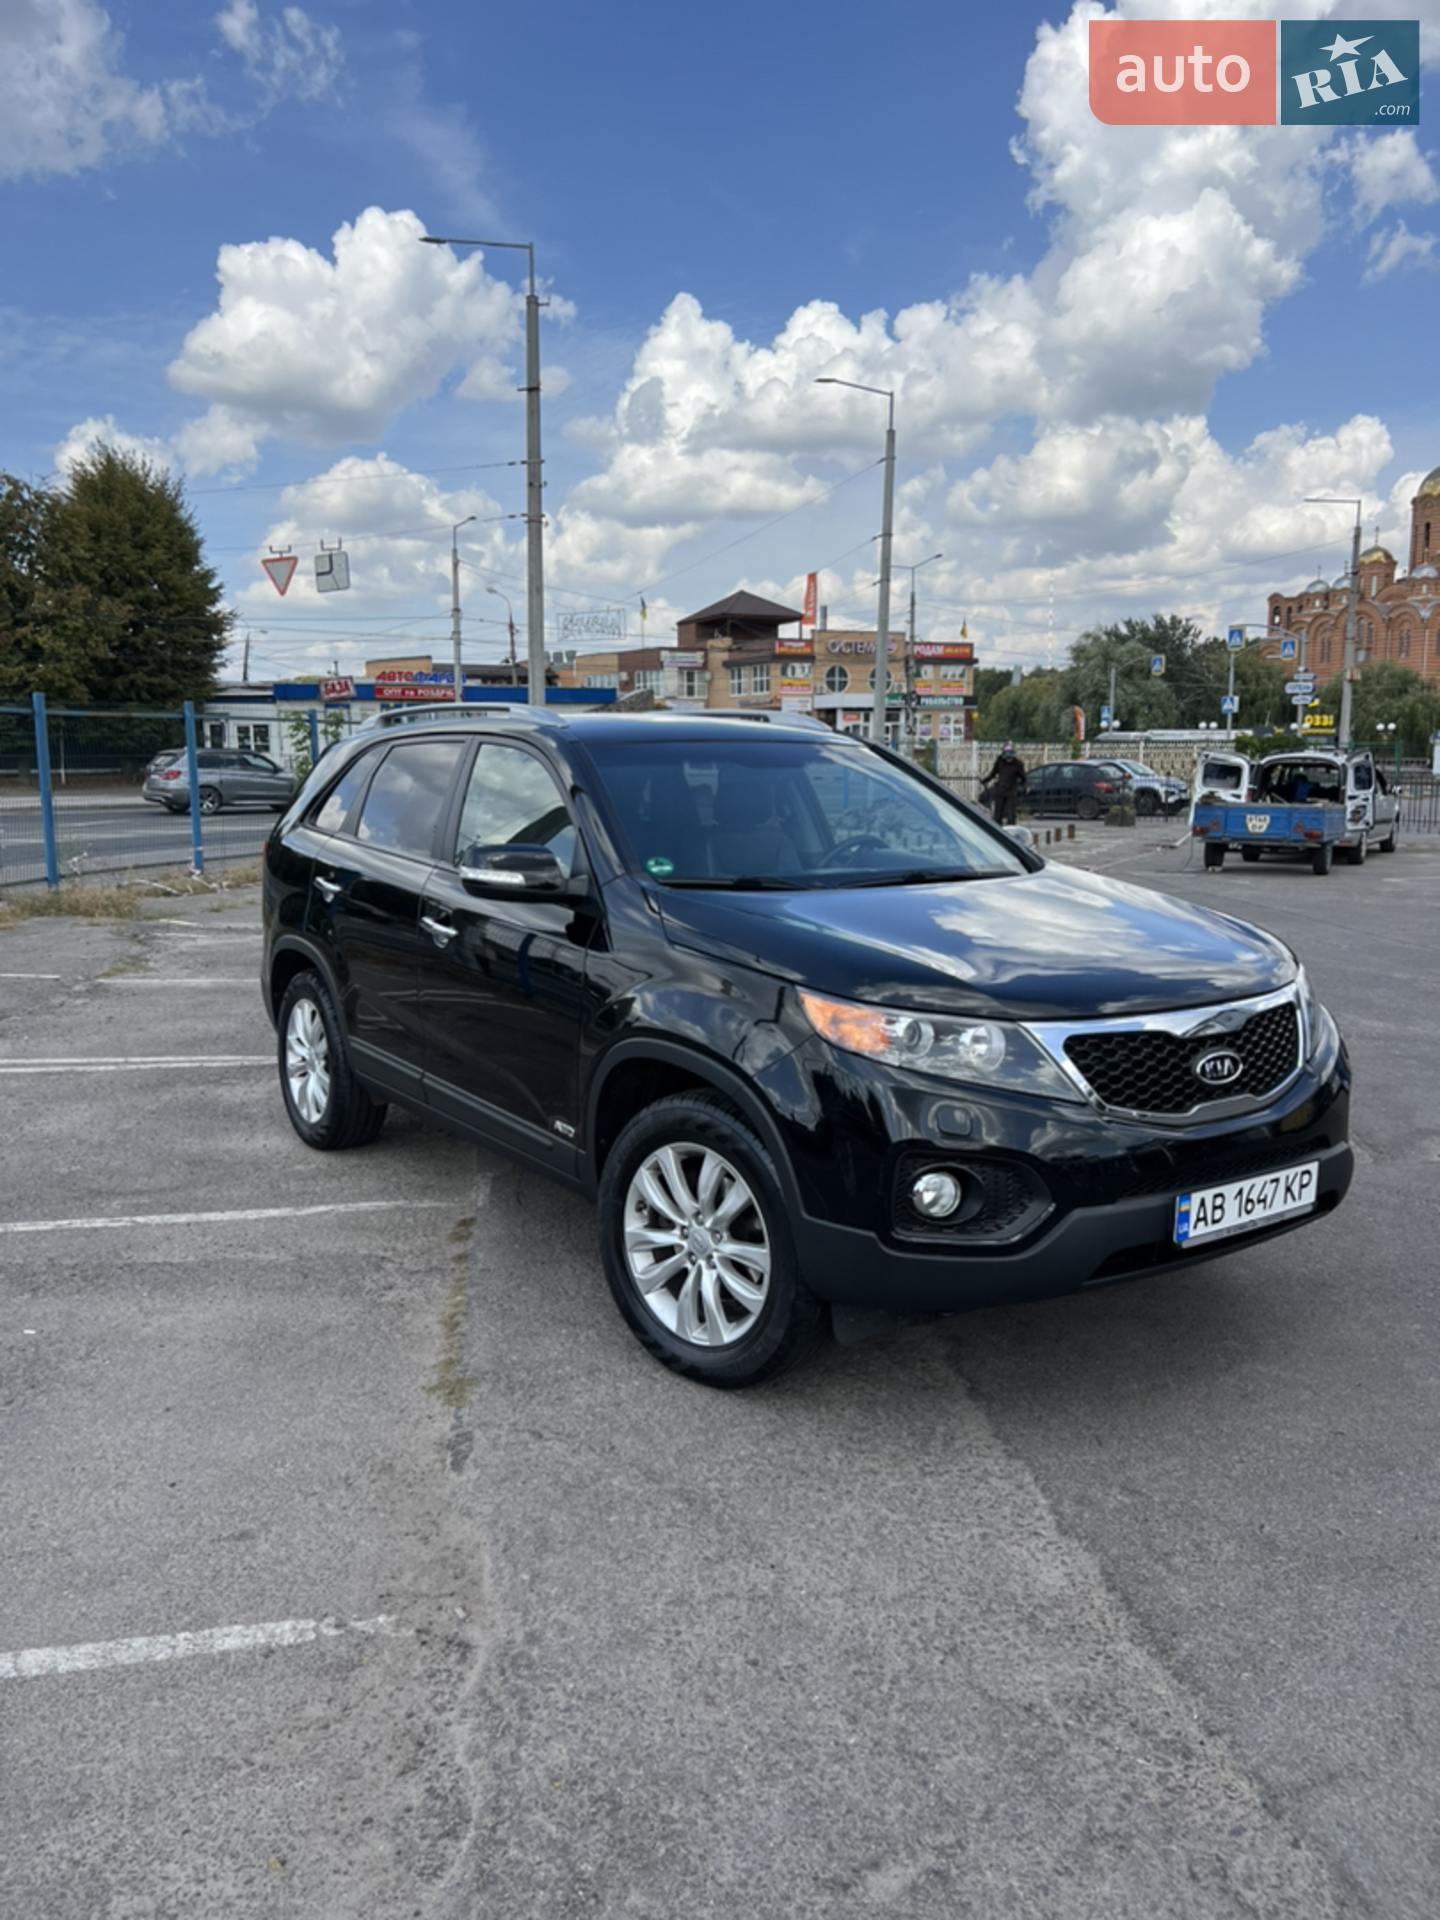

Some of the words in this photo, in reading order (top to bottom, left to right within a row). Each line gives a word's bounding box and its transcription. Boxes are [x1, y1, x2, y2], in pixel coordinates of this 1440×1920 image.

[1205, 1058, 1235, 1078] KIA
[1193, 1192, 1226, 1230] AB
[1233, 1176, 1281, 1218] 1647
[1283, 1169, 1313, 1205] KP
